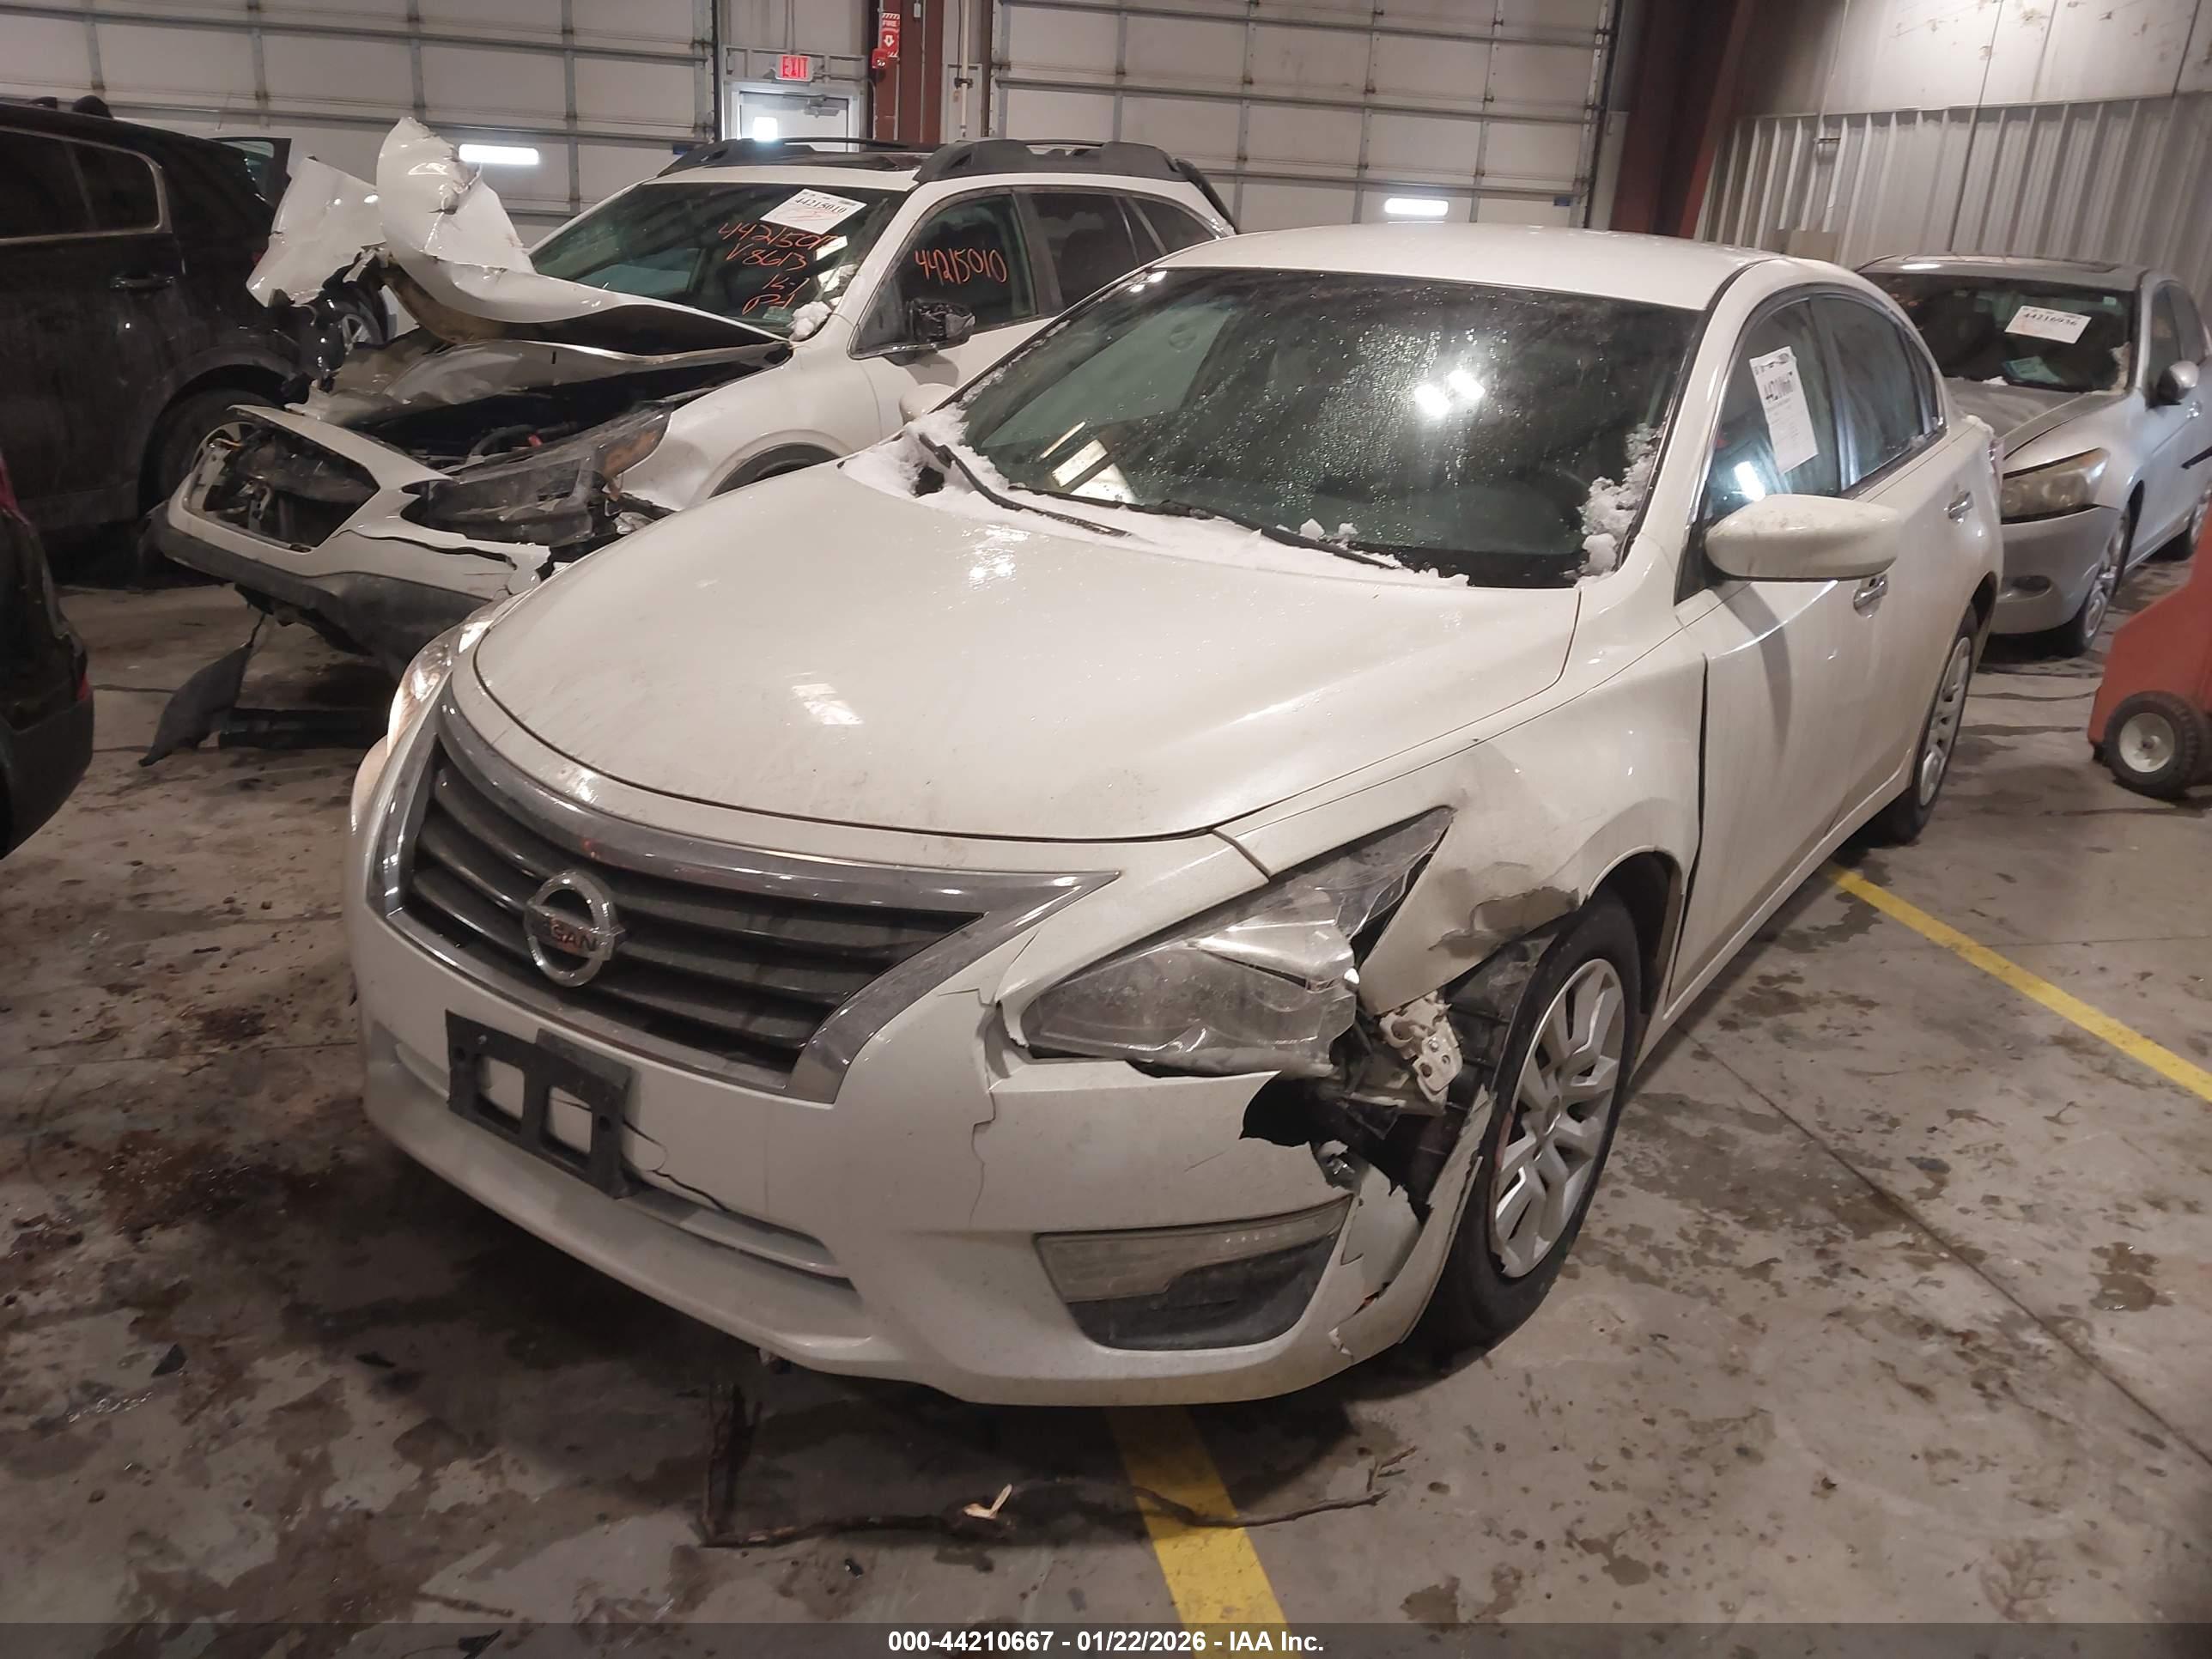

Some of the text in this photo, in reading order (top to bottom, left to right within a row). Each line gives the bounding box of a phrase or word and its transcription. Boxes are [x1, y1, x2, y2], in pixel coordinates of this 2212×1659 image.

[781, 56, 808, 78] EXIT
[795, 197, 848, 214] 44215010
[915, 247, 1007, 286] 44215010
